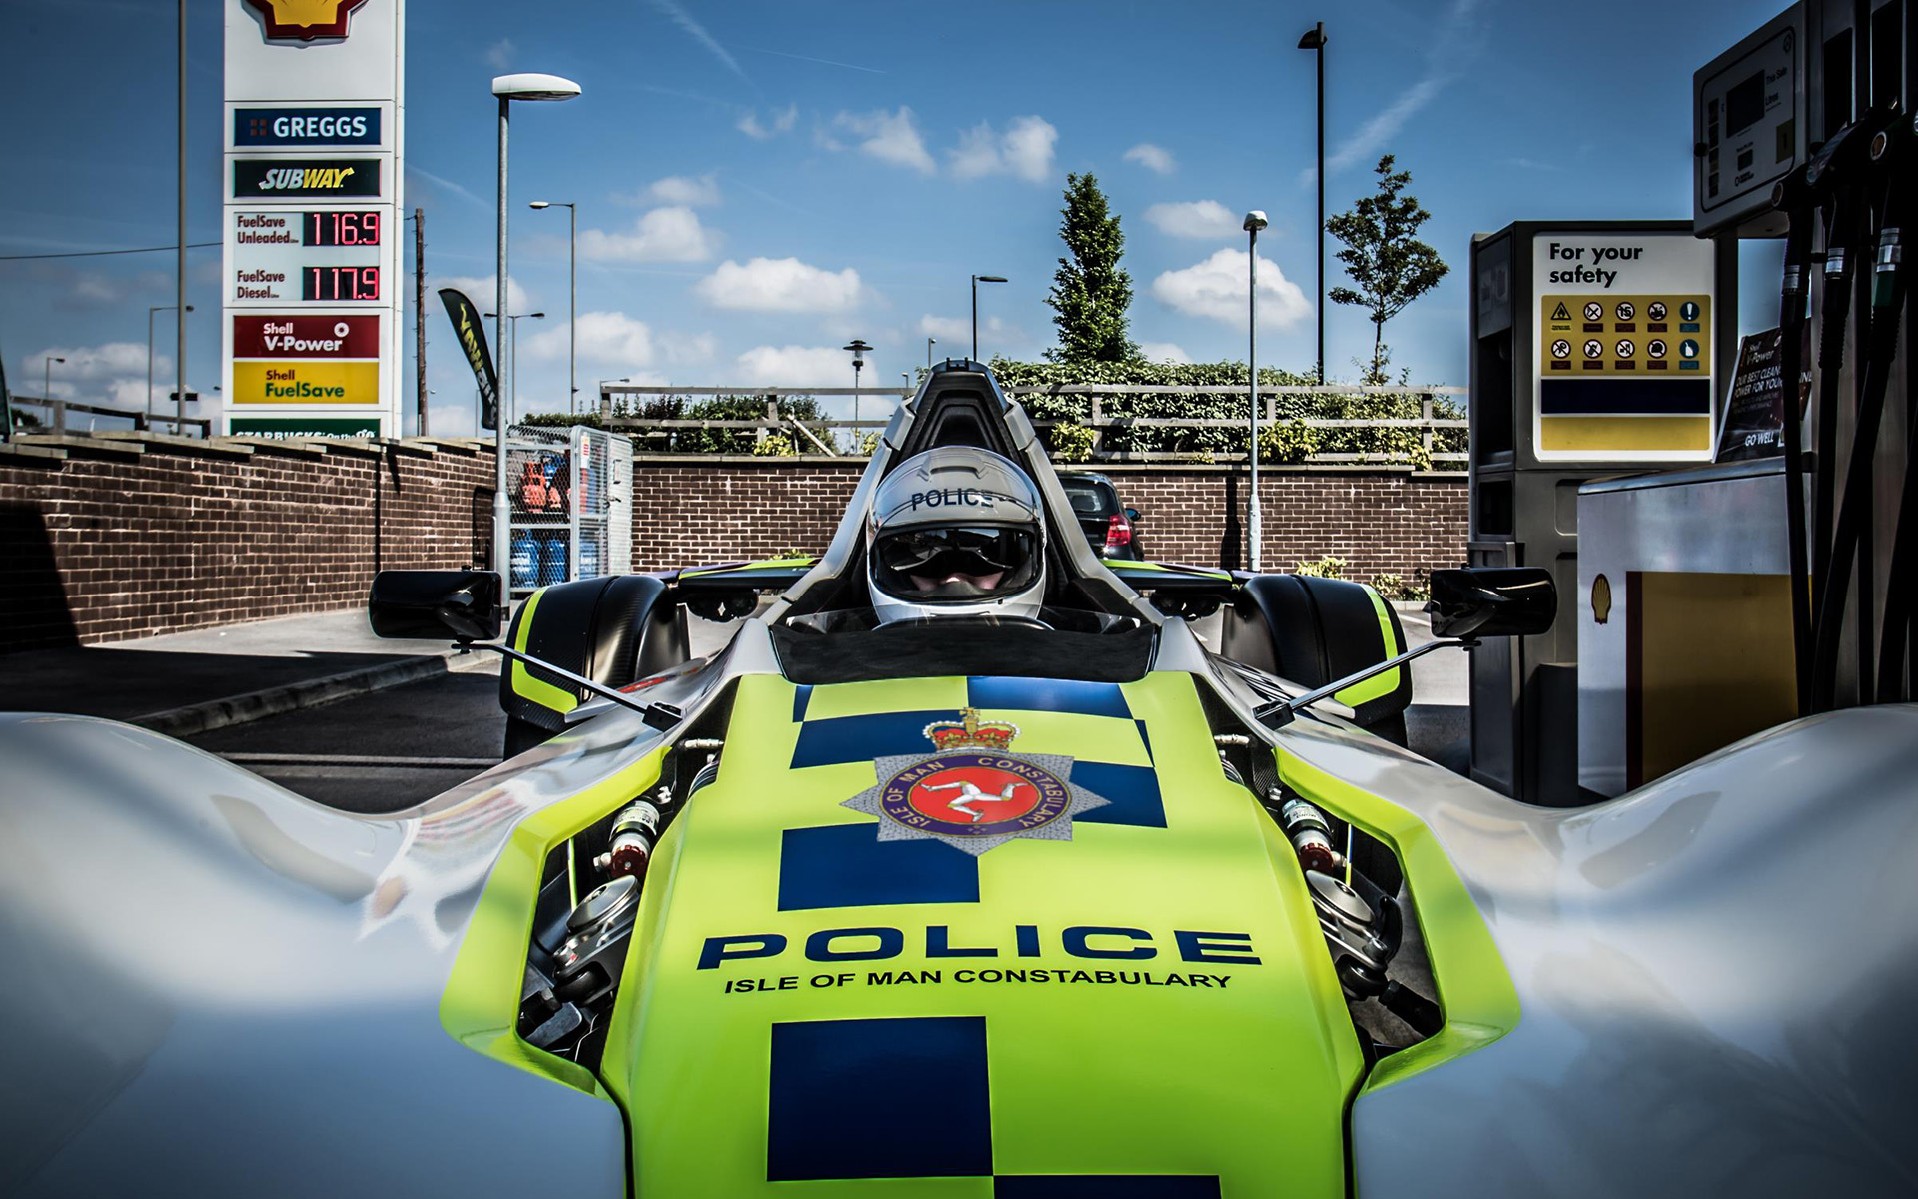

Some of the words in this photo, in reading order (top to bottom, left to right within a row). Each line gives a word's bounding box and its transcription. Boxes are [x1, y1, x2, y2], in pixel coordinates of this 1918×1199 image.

[273, 116, 367, 138] GREGGS
[259, 167, 355, 190] SUBWAY
[237, 214, 285, 228] FuelSave
[313, 213, 380, 245] 116.9
[237, 231, 290, 244] Unleaded
[1550, 243, 1584, 260] For
[1591, 247, 1643, 265] your
[237, 269, 285, 283] FuelSave
[313, 268, 380, 300] 117.9
[1549, 265, 1617, 288] safety
[237, 286, 271, 299] Diesel
[264, 322, 294, 334] Shell
[264, 335, 343, 352] V-Power
[266, 370, 295, 381] Shell
[265, 382, 345, 397] FuelSave
[1744, 434, 1757, 447] GO
[1757, 431, 1774, 444] WELL
[911, 488, 994, 511] POLICE
[899, 761, 945, 782] MAN
[886, 787, 904, 802] OF
[978, 757, 1064, 828] CONSTABULARY
[890, 806, 932, 827] ISLE
[697, 925, 1262, 970] POLICE
[725, 976, 799, 993] ISLE
[810, 973, 855, 988] OF
[867, 970, 942, 985] MAN
[954, 969, 1232, 988] CONSTABULARY
